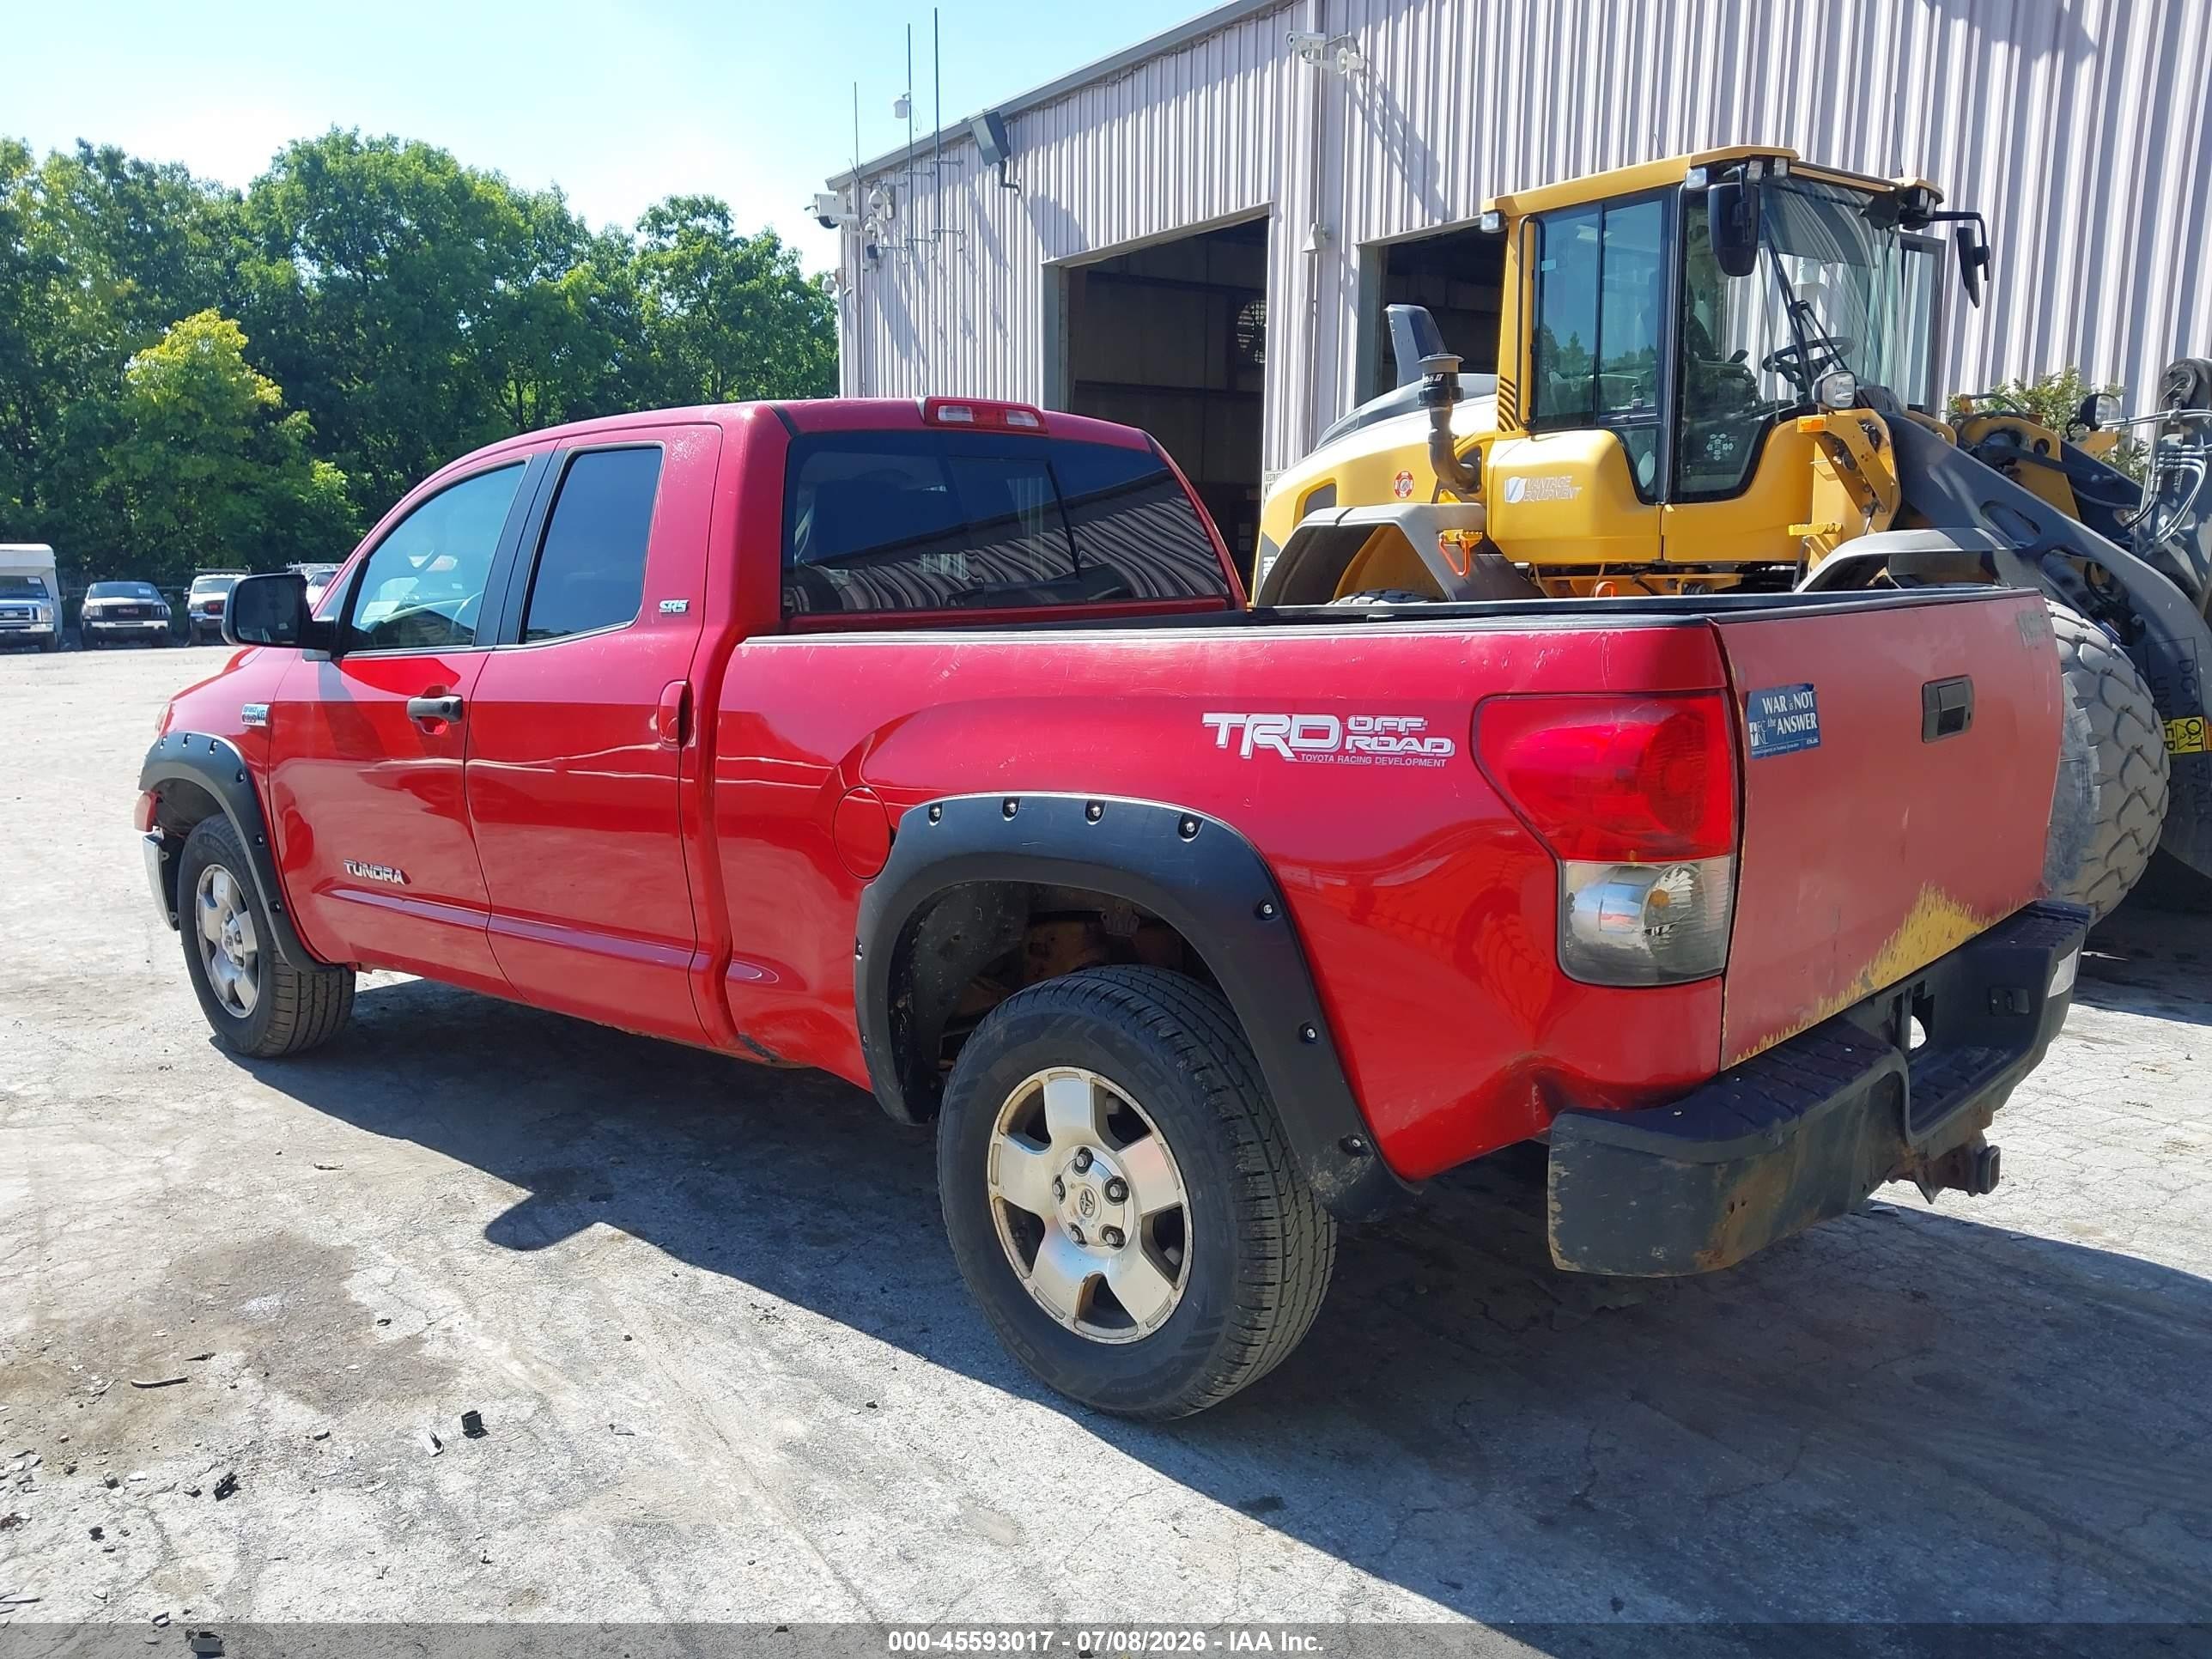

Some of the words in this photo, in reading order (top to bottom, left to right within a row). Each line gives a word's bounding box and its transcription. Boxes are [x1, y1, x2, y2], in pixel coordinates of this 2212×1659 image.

[1522, 487, 1582, 501] EQUIPMENT
[1762, 695, 1788, 714] WAR
[1789, 700, 1794, 711] is
[1793, 691, 1814, 710] NOT
[1347, 715, 1428, 735] OFF
[1767, 716, 1777, 727] the
[1777, 713, 1818, 735] ANSWER
[1201, 712, 1342, 762] TRD
[1345, 735, 1455, 757] ROAD
[1301, 753, 1334, 763] TOYOTA
[1337, 755, 1372, 764] RACING
[1375, 757, 1447, 768] DEVELOPMENT
[343, 859, 405, 885] TUNDRA
